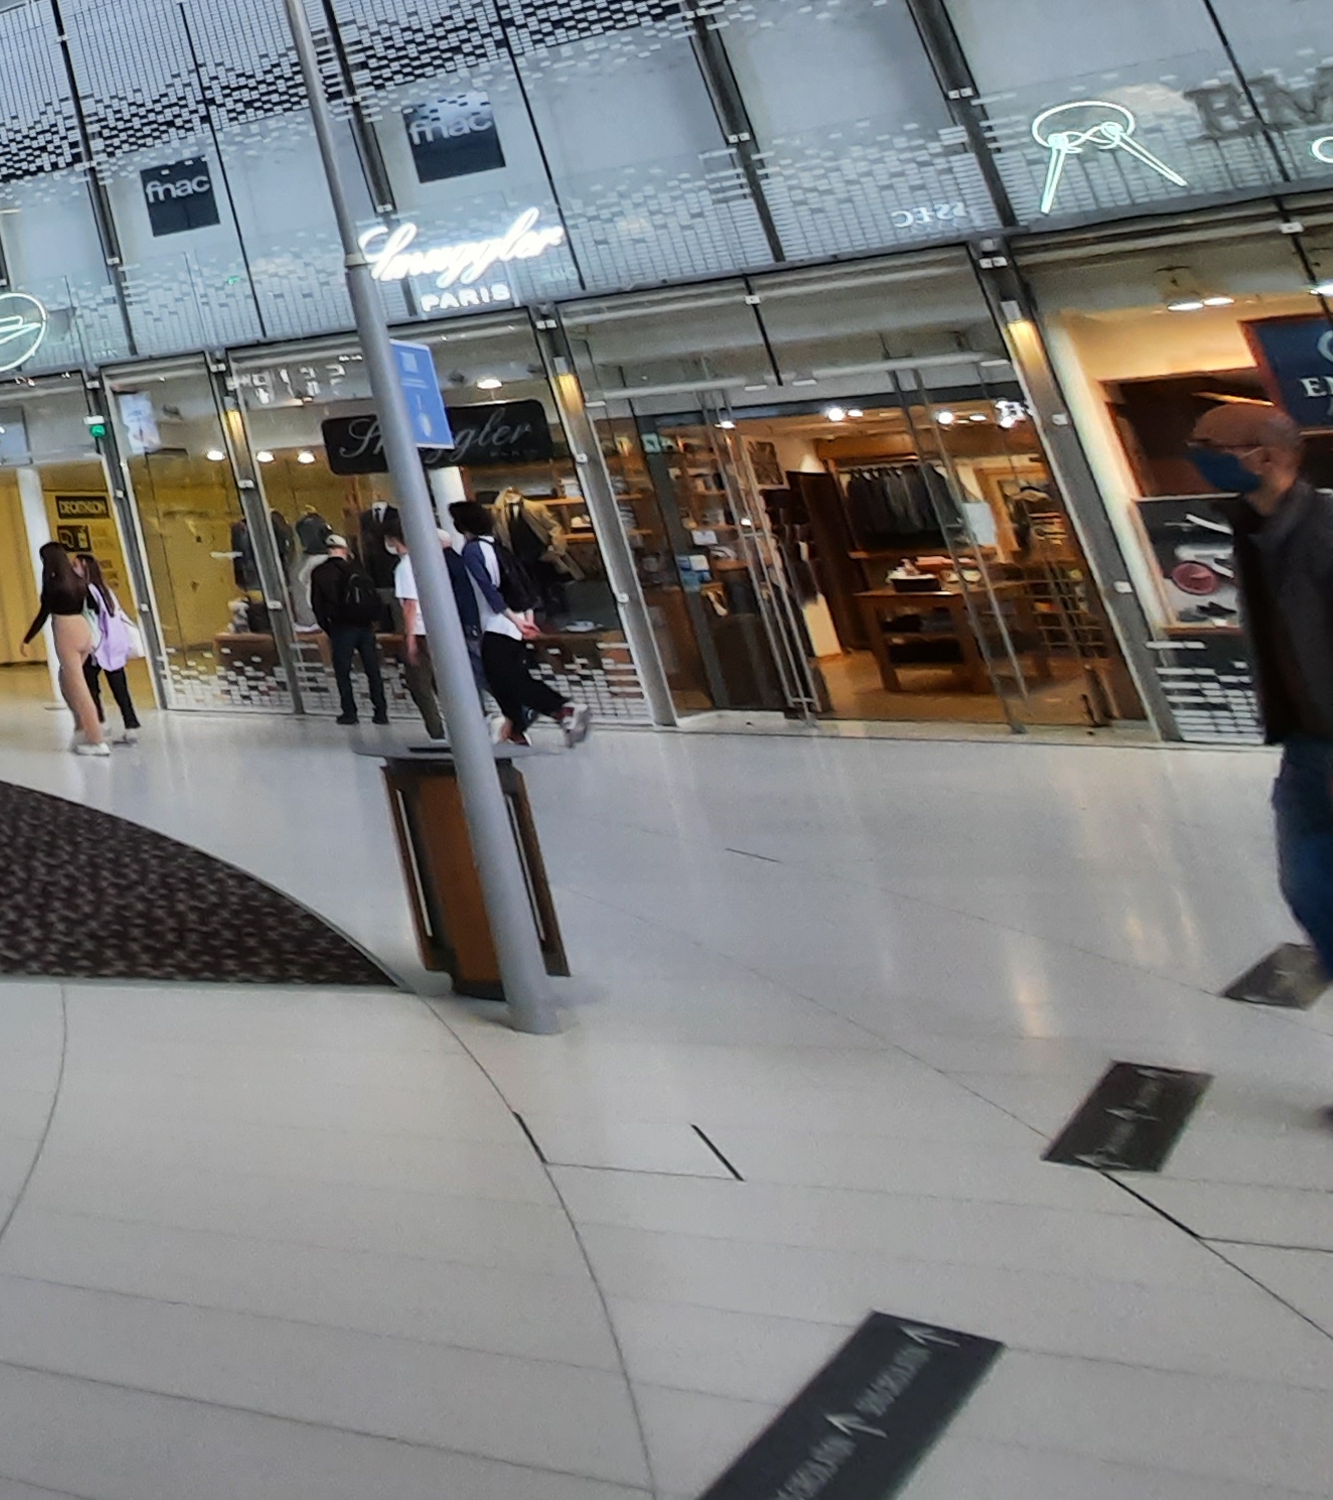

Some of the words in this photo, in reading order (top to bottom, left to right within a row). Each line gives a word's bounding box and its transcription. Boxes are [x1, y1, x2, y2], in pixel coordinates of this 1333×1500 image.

[409, 114, 492, 146] fnac
[145, 175, 211, 203] fnac
[420, 283, 511, 312] PARIS
